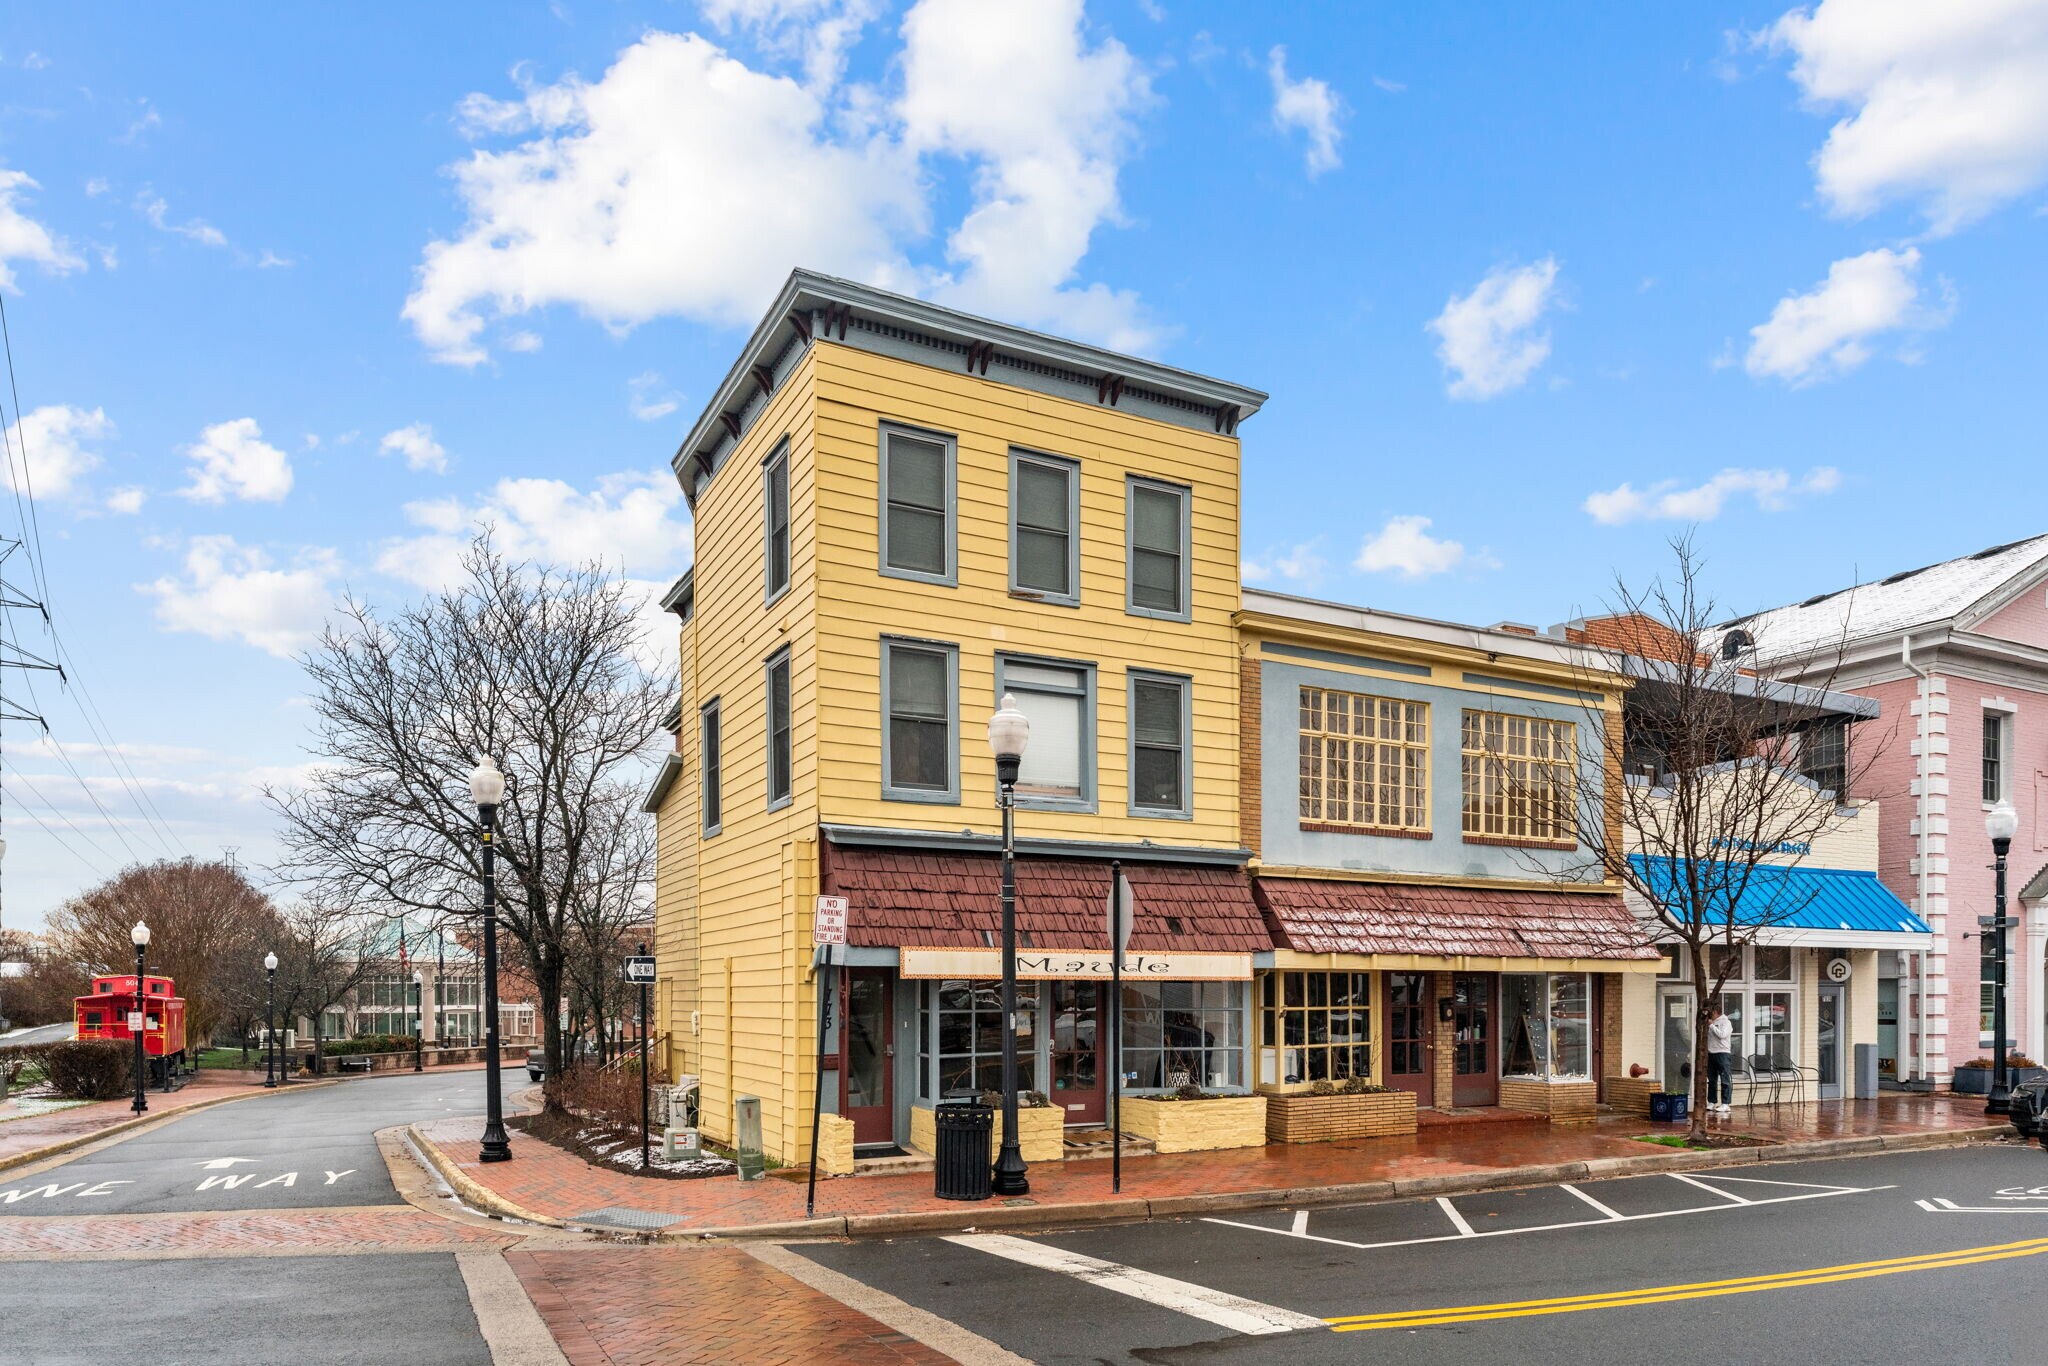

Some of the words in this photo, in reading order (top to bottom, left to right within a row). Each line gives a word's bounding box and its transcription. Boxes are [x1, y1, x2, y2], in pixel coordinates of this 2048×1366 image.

[826, 899, 838, 908] NO
[820, 908, 843, 917] PARKING
[818, 924, 843, 934] STANDING
[816, 932, 827, 940] FIRE
[829, 933, 843, 942] LANE
[634, 964, 643, 975] ONE
[643, 964, 653, 975] WAY
[1016, 956, 1170, 974] Maude
[0, 1180, 137, 1204] NE
[194, 1169, 357, 1192] WAY
